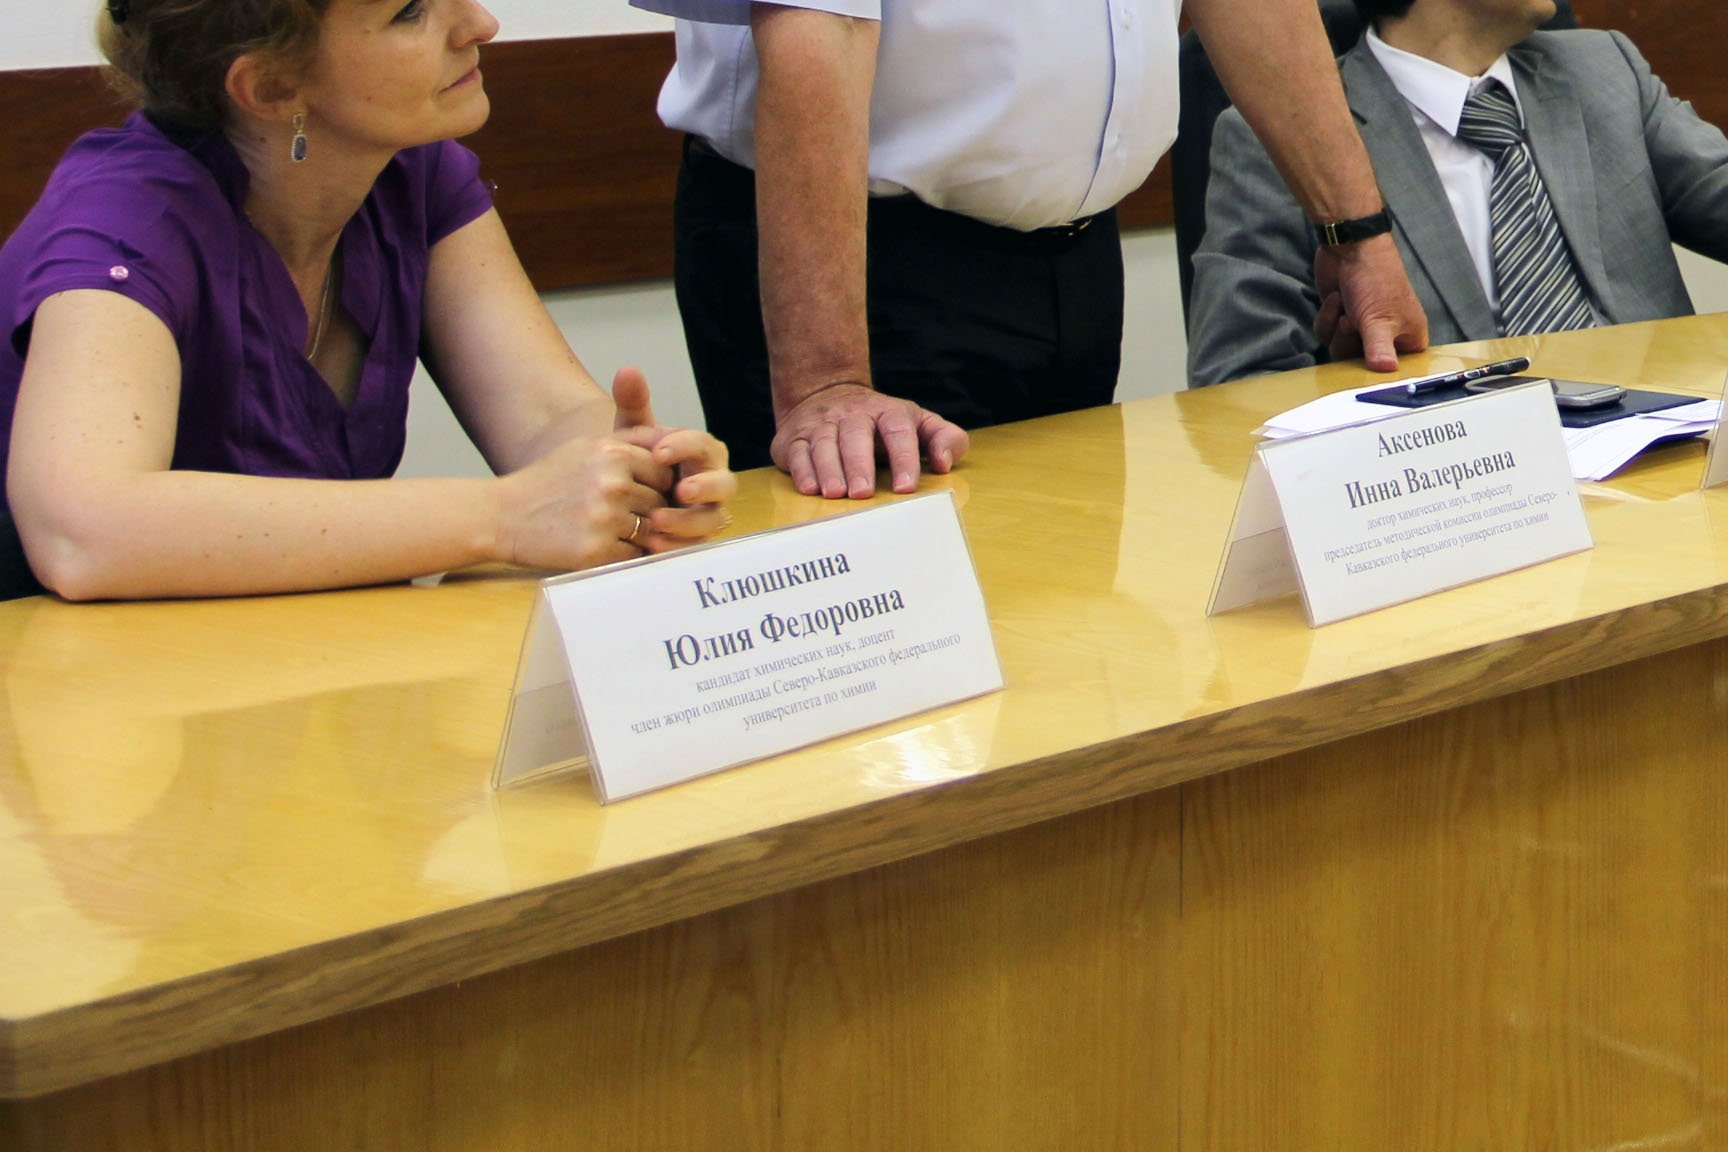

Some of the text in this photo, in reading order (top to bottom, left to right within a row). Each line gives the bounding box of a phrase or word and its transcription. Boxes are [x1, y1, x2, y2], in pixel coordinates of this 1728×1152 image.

[1377, 419, 1467, 457] Аксенова
[1345, 448, 1515, 509] Инна Валерьевна
[1367, 513, 1397, 530] доктор
[1399, 500, 1447, 521] химических
[1471, 483, 1513, 504] профессор
[1324, 538, 1382, 563] председатель
[1384, 519, 1442, 545] методической
[1443, 511, 1482, 529] комиссии
[1483, 499, 1527, 518] олимпиады
[1346, 512, 1550, 576] Кавказского федерального университета по химии
[693, 552, 851, 609] Клюшкина
[662, 586, 905, 670] Юлия Федоровна
[631, 633, 961, 734] член жюри олимпиады Северо-Кавказского федерального
[696, 629, 896, 693] кандидат химических наук, доцент
[743, 680, 877, 731] университета по химии
